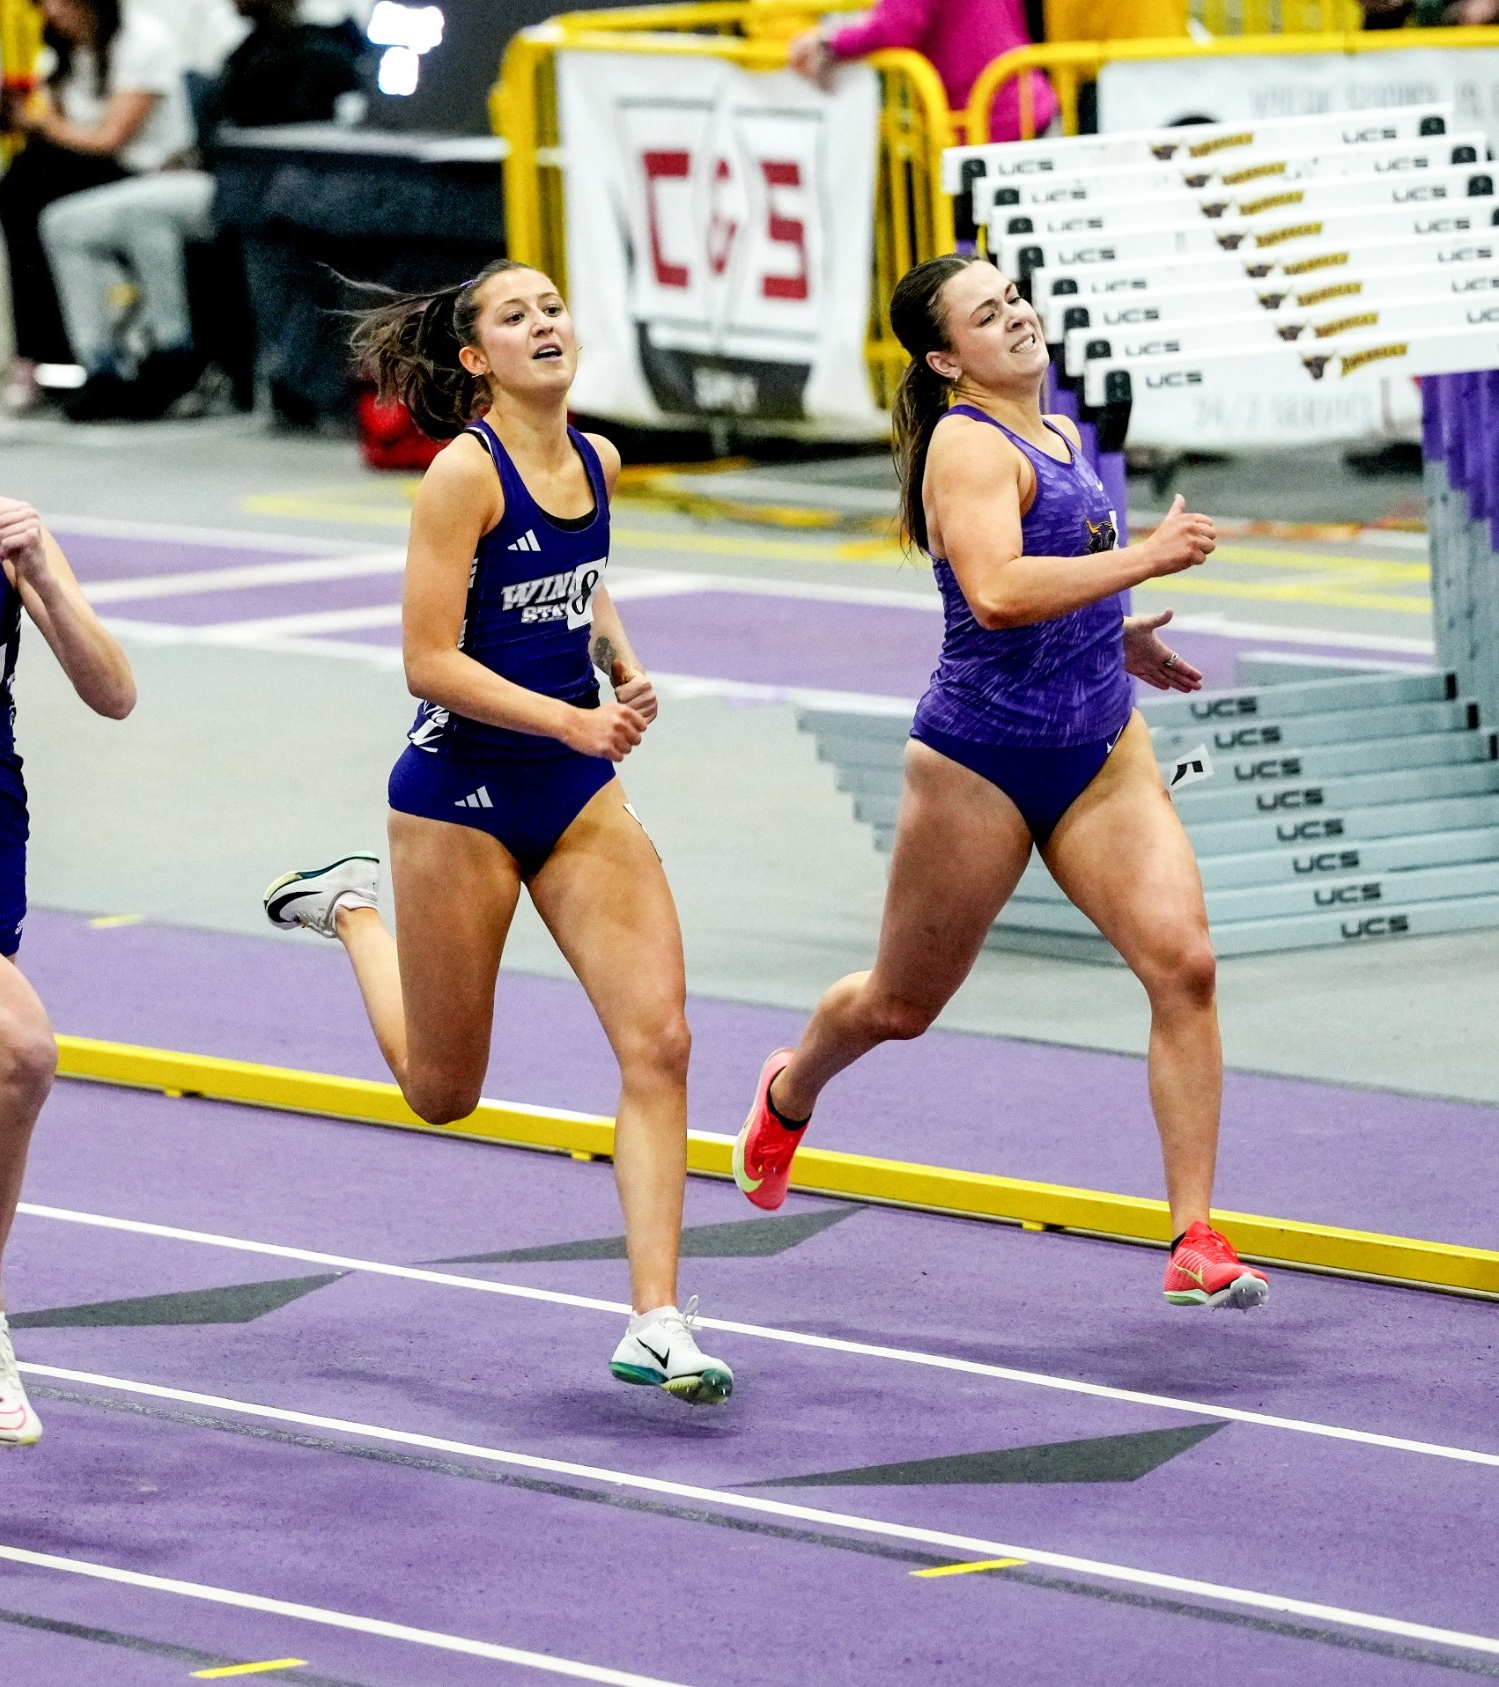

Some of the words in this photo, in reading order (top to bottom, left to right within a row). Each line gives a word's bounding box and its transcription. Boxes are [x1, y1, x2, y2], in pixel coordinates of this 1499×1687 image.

[1058, 248, 1116, 264] UCS
[1104, 308, 1160, 325] UCS
[1125, 339, 1180, 356] UCS
[1145, 370, 1203, 388] UCS
[571, 569, 599, 615] 8
[1190, 696, 1258, 719] UCS
[1214, 725, 1281, 748] UCS
[1235, 757, 1301, 781] UCS
[1256, 788, 1324, 811] UCS
[1276, 818, 1344, 841] UCS
[1293, 850, 1360, 873] UCS
[1313, 882, 1381, 905] UCS
[1340, 914, 1408, 938] UCS
